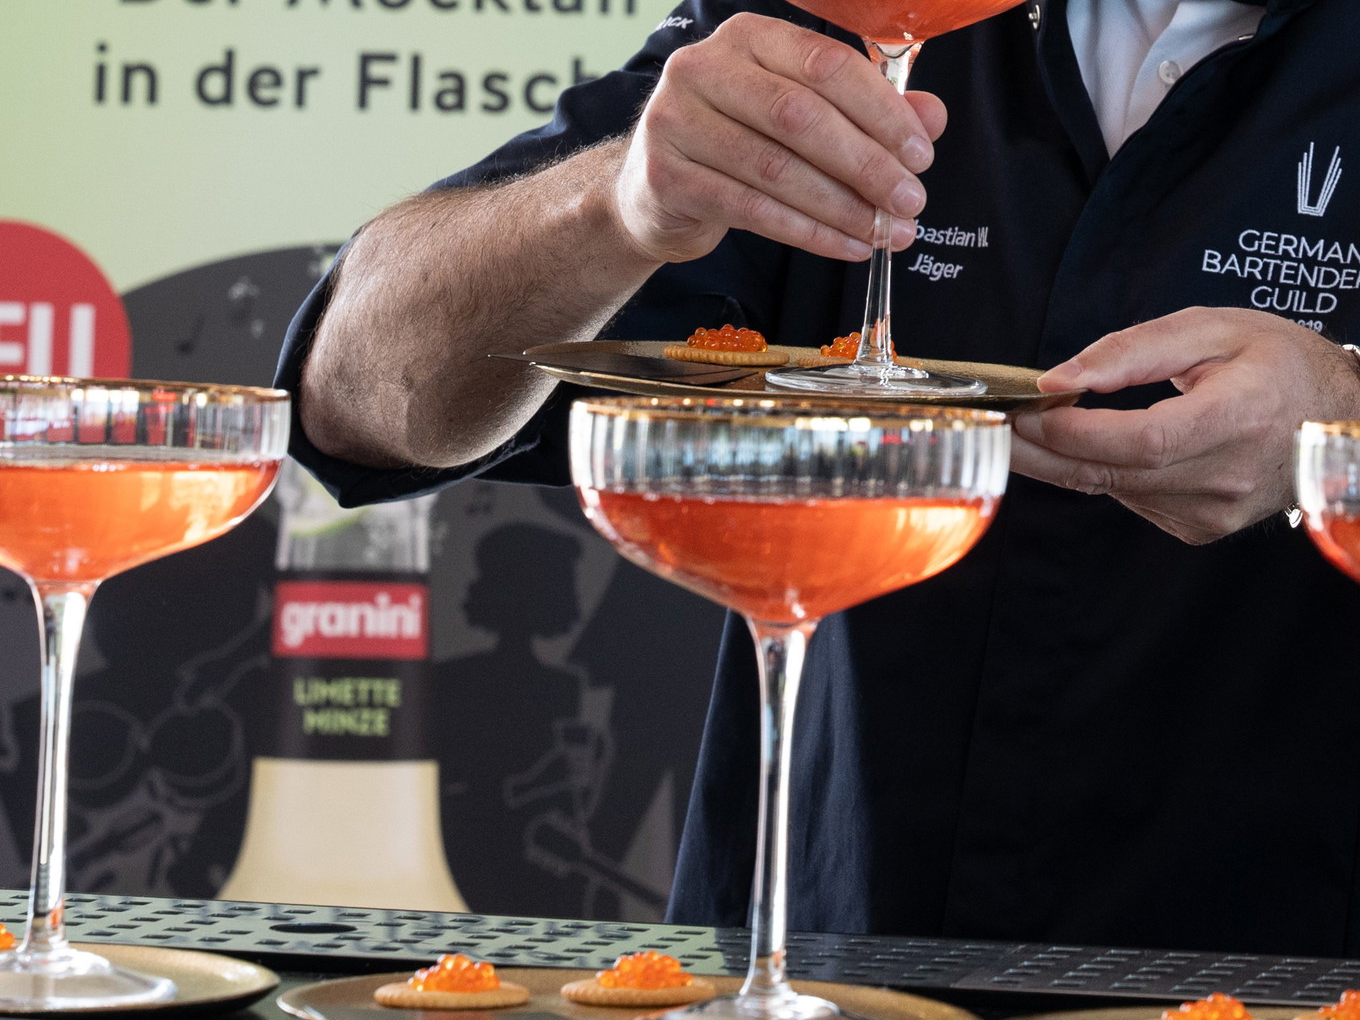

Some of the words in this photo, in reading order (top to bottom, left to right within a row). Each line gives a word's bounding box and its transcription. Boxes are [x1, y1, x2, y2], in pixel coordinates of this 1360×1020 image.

[93, 43, 159, 107] in
[194, 47, 321, 110] der
[915, 219, 976, 247] bastian
[908, 253, 963, 281] Jäger
[1251, 285, 1338, 313] GUILD
[280, 591, 422, 649] granini
[293, 676, 400, 708] LIMETTE
[303, 707, 391, 737] MINZE
